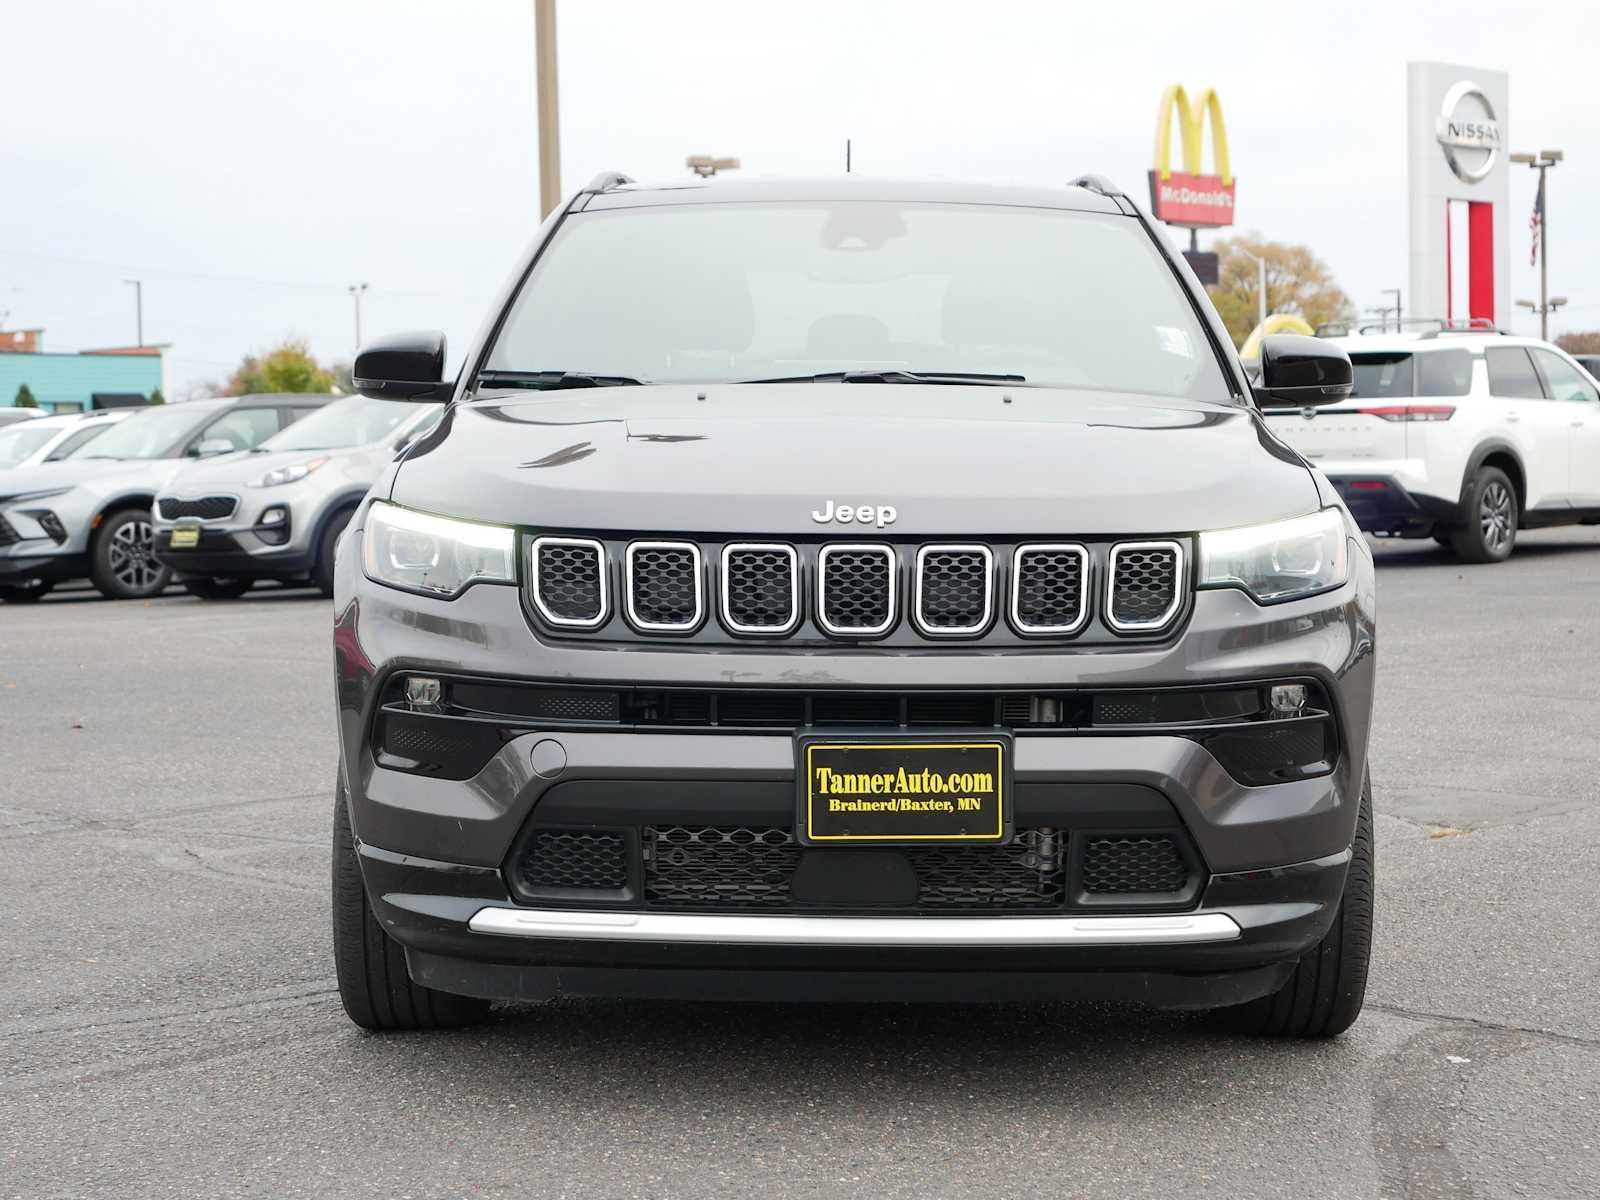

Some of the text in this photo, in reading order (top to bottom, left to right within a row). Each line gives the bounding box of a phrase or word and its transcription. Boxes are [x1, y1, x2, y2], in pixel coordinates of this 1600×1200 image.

[1160, 186, 1233, 207] McDonald's
[812, 500, 897, 528] Jeep
[816, 767, 993, 794] TannerAuto.com
[829, 798, 981, 813] Brainerd/Baxter, MN
